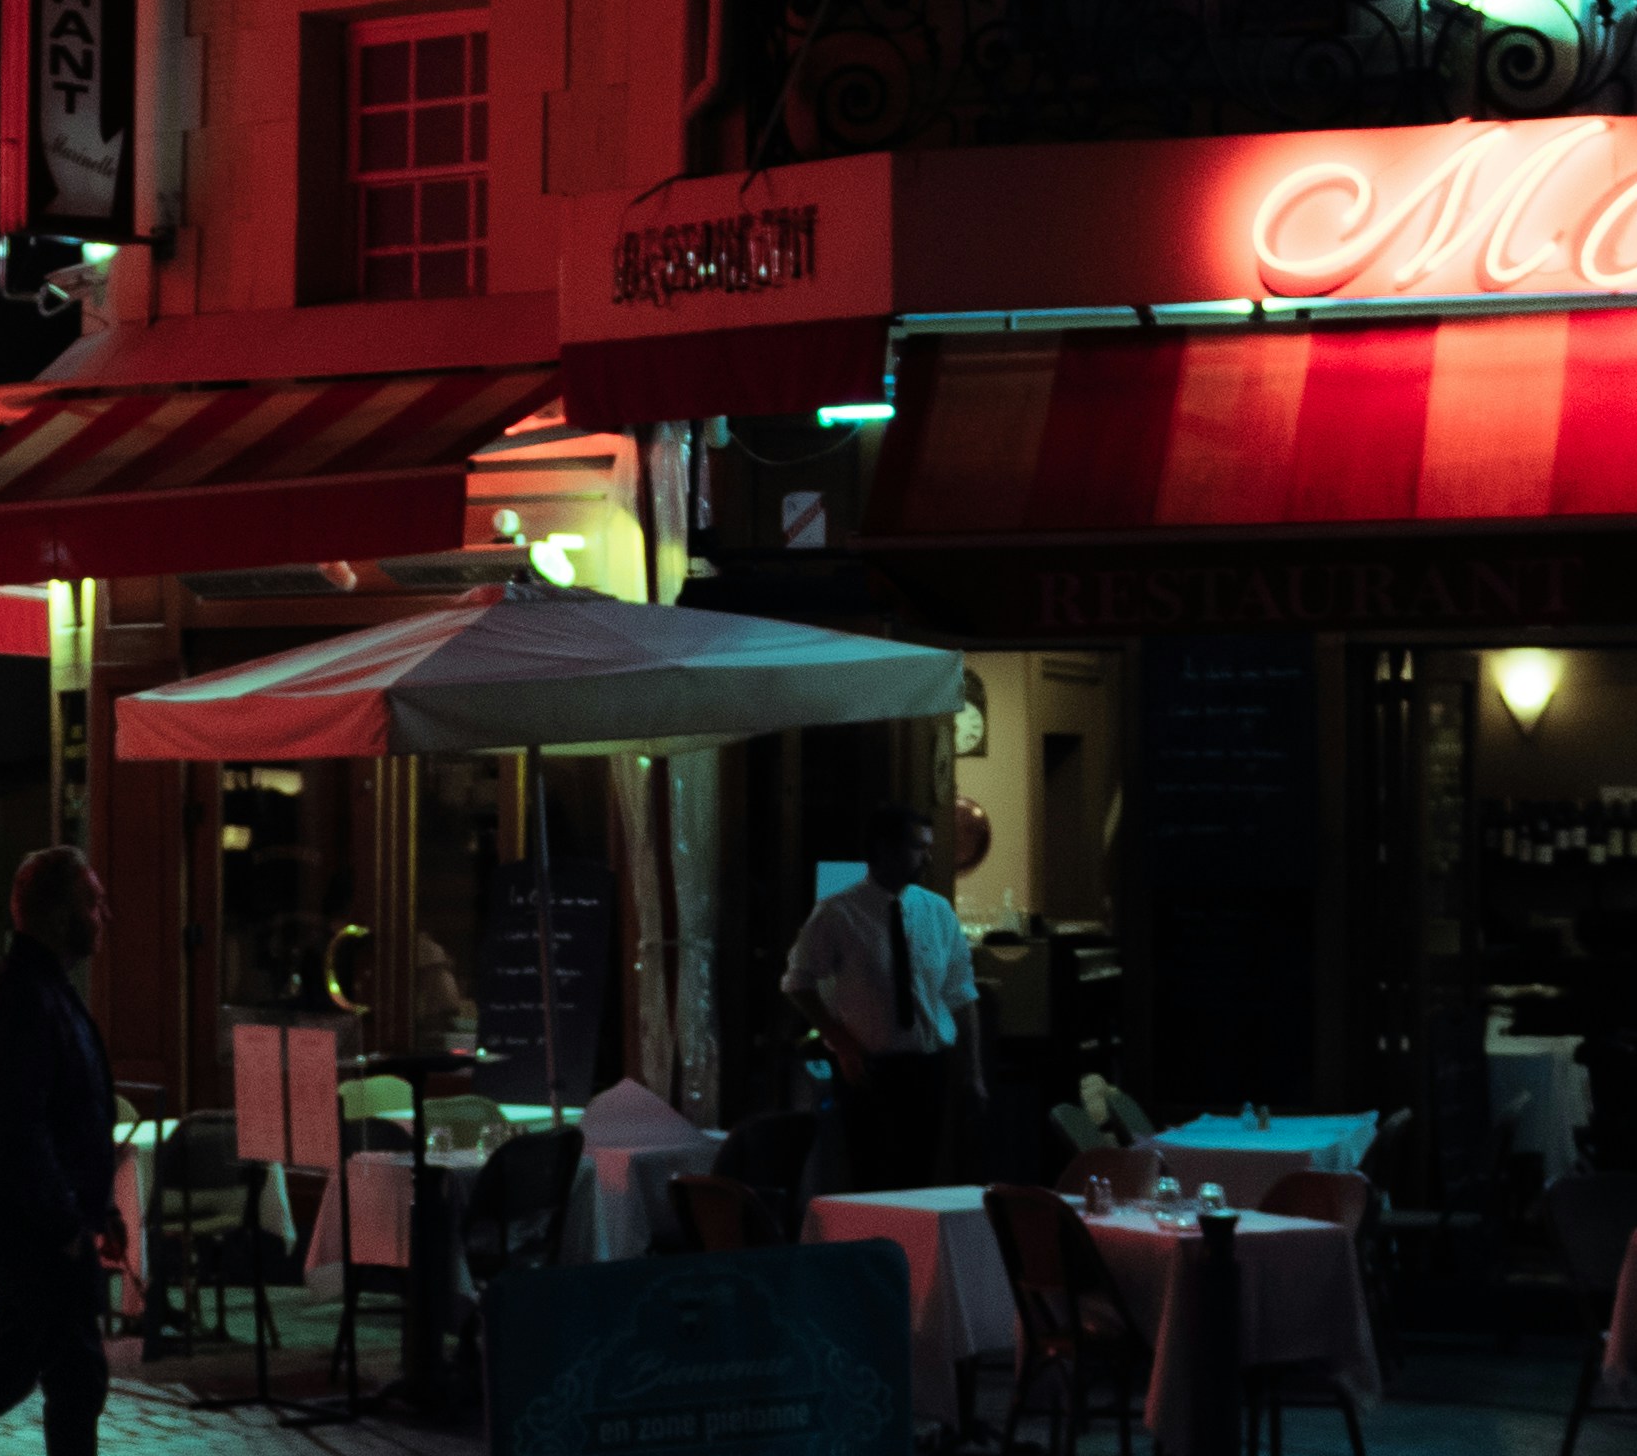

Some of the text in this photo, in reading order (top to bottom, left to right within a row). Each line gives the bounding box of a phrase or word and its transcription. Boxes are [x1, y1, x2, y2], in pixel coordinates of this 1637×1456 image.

[1035, 555, 1586, 628] RESTAURANT
[598, 1416, 630, 1445] en
[637, 1409, 696, 1442] zone
